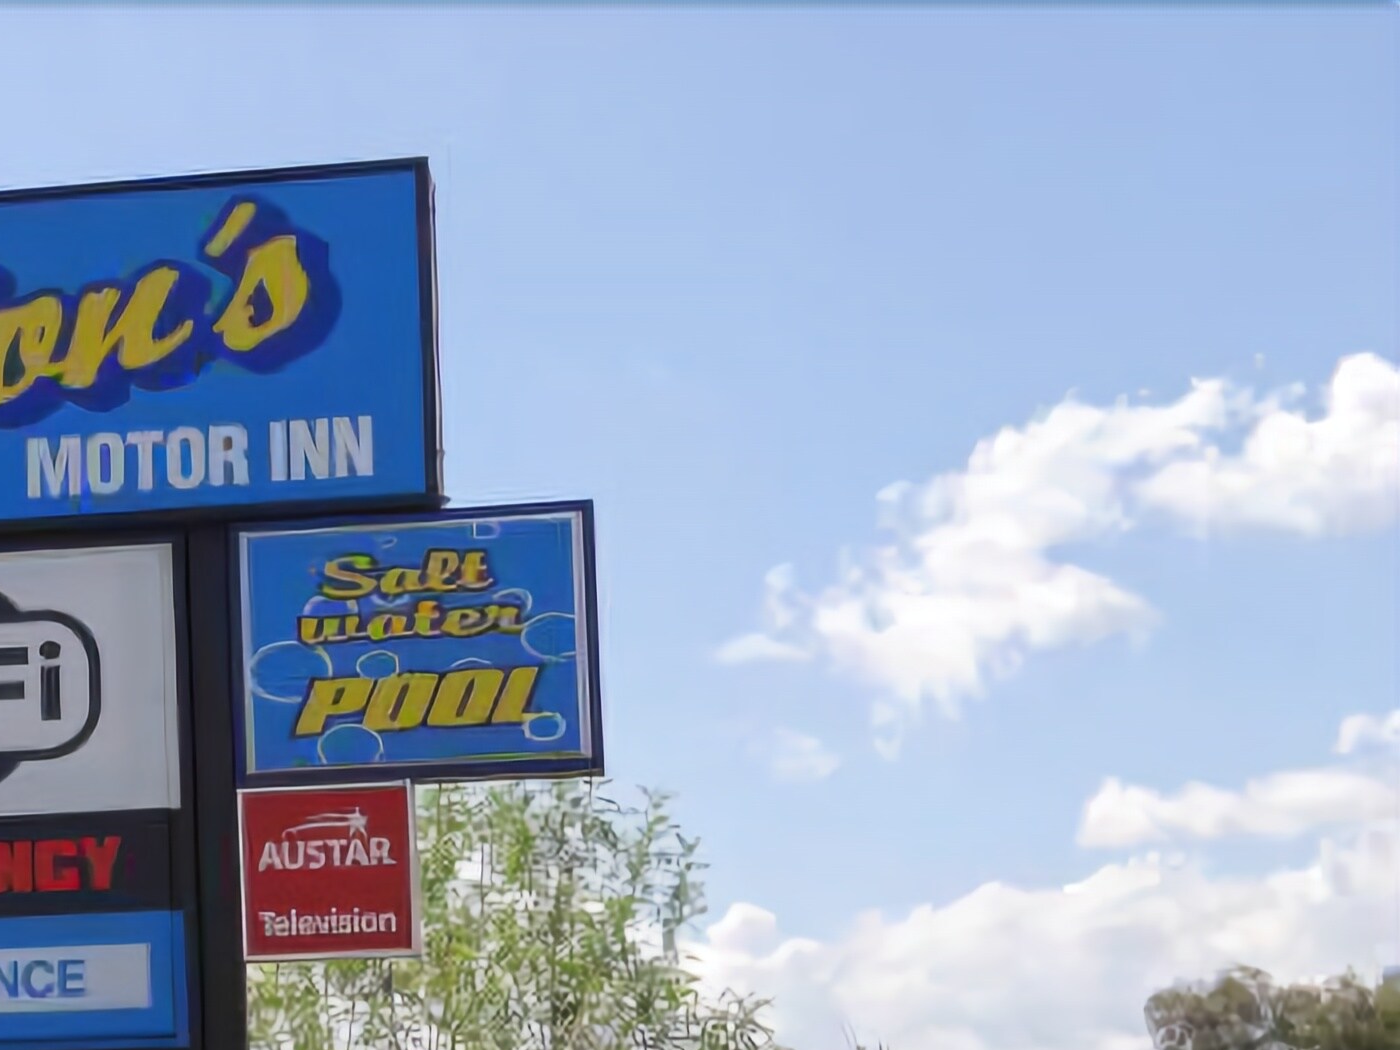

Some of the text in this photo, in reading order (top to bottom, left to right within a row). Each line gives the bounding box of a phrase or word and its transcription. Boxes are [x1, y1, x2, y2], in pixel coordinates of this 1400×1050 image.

[25, 414, 374, 499] MOTOR INN
[321, 547, 495, 599] Salt
[297, 600, 526, 645] water
[258, 836, 398, 872] AUSTAR
[258, 907, 398, 937] Television
